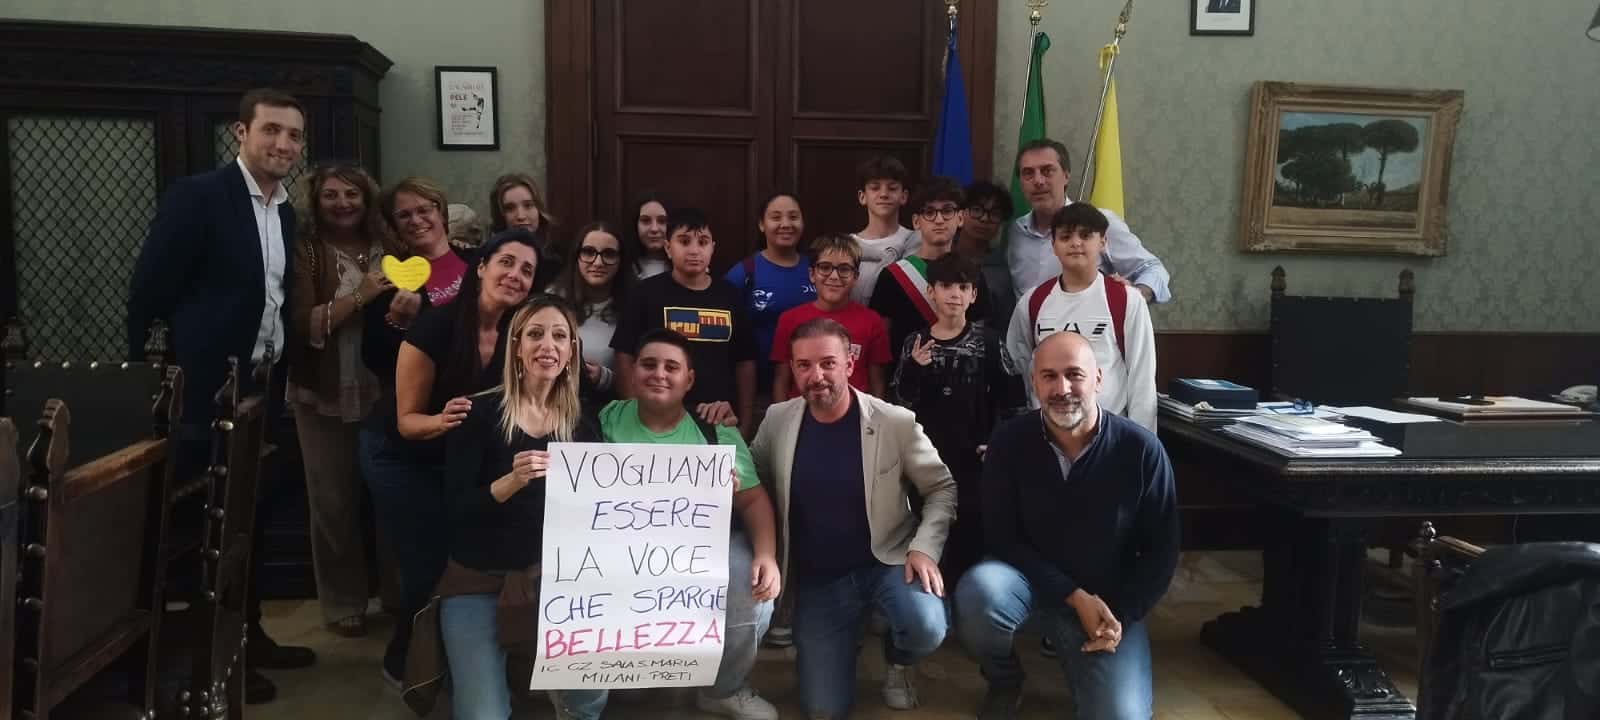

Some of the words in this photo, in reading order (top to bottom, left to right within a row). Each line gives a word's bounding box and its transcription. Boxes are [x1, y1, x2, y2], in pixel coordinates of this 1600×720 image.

[560, 449, 733, 493] VOGLIAMO
[591, 497, 720, 531] ESSERE
[555, 546, 603, 582] LA
[628, 542, 712, 576] VOCE
[544, 593, 612, 624] CHE
[630, 585, 728, 613] SPARGE
[545, 618, 722, 660] BELLEZZA
[582, 672, 641, 683] MILANI
[648, 670, 692, 681] PRETI
